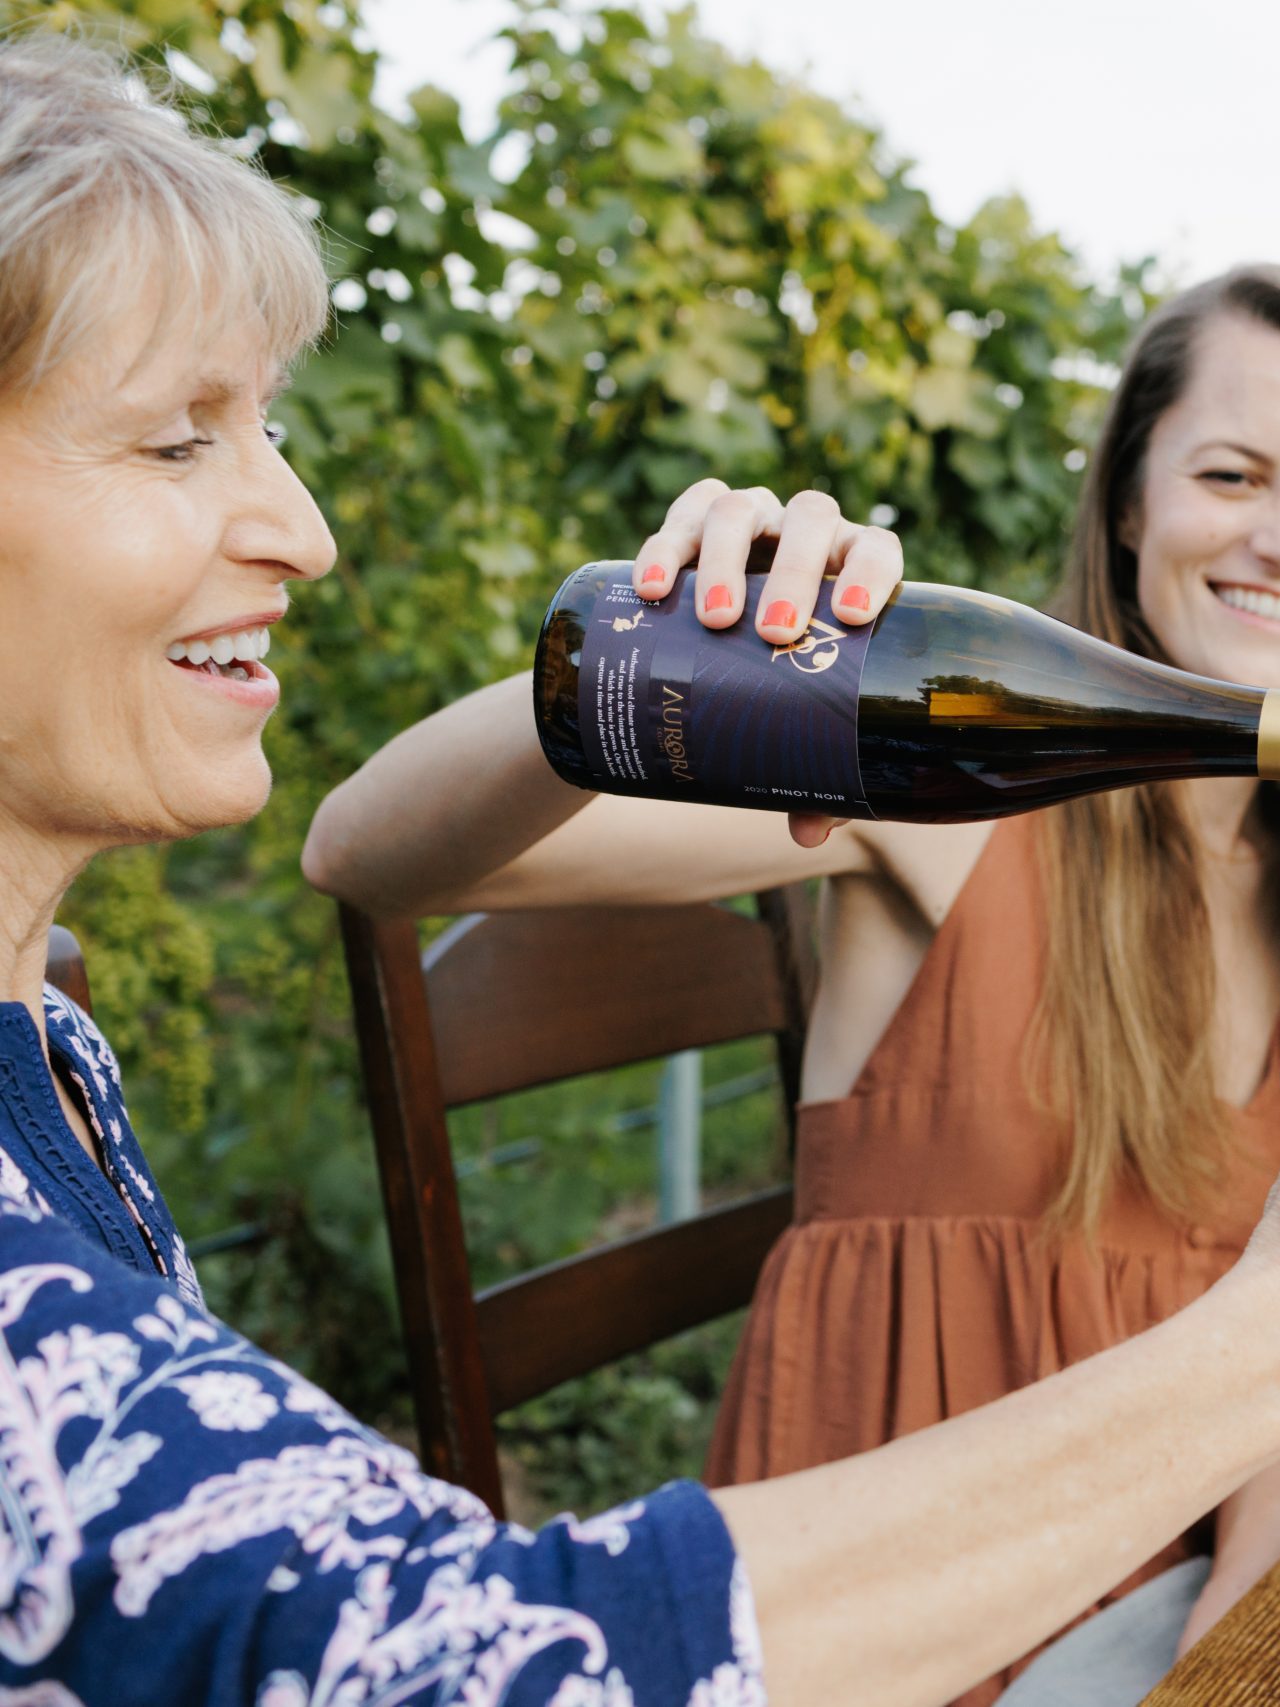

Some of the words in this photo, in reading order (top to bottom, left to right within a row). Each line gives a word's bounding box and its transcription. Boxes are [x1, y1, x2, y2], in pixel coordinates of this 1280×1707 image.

[597, 656, 606, 684] capture
[629, 647, 640, 683] Authentic
[607, 669, 616, 691] which
[597, 691, 605, 708] time
[607, 693, 615, 705] the
[617, 692, 624, 700] to
[627, 684, 635, 700] cool
[597, 708, 606, 722] and
[607, 706, 615, 722] wine
[617, 701, 625, 713] the
[627, 700, 635, 727] climate
[597, 723, 606, 741] place
[662, 684, 695, 783] AURORA
[621, 738, 630, 751] and
[602, 748, 612, 761] each
[771, 787, 810, 798] PINOT
[813, 792, 846, 802] NOIR
